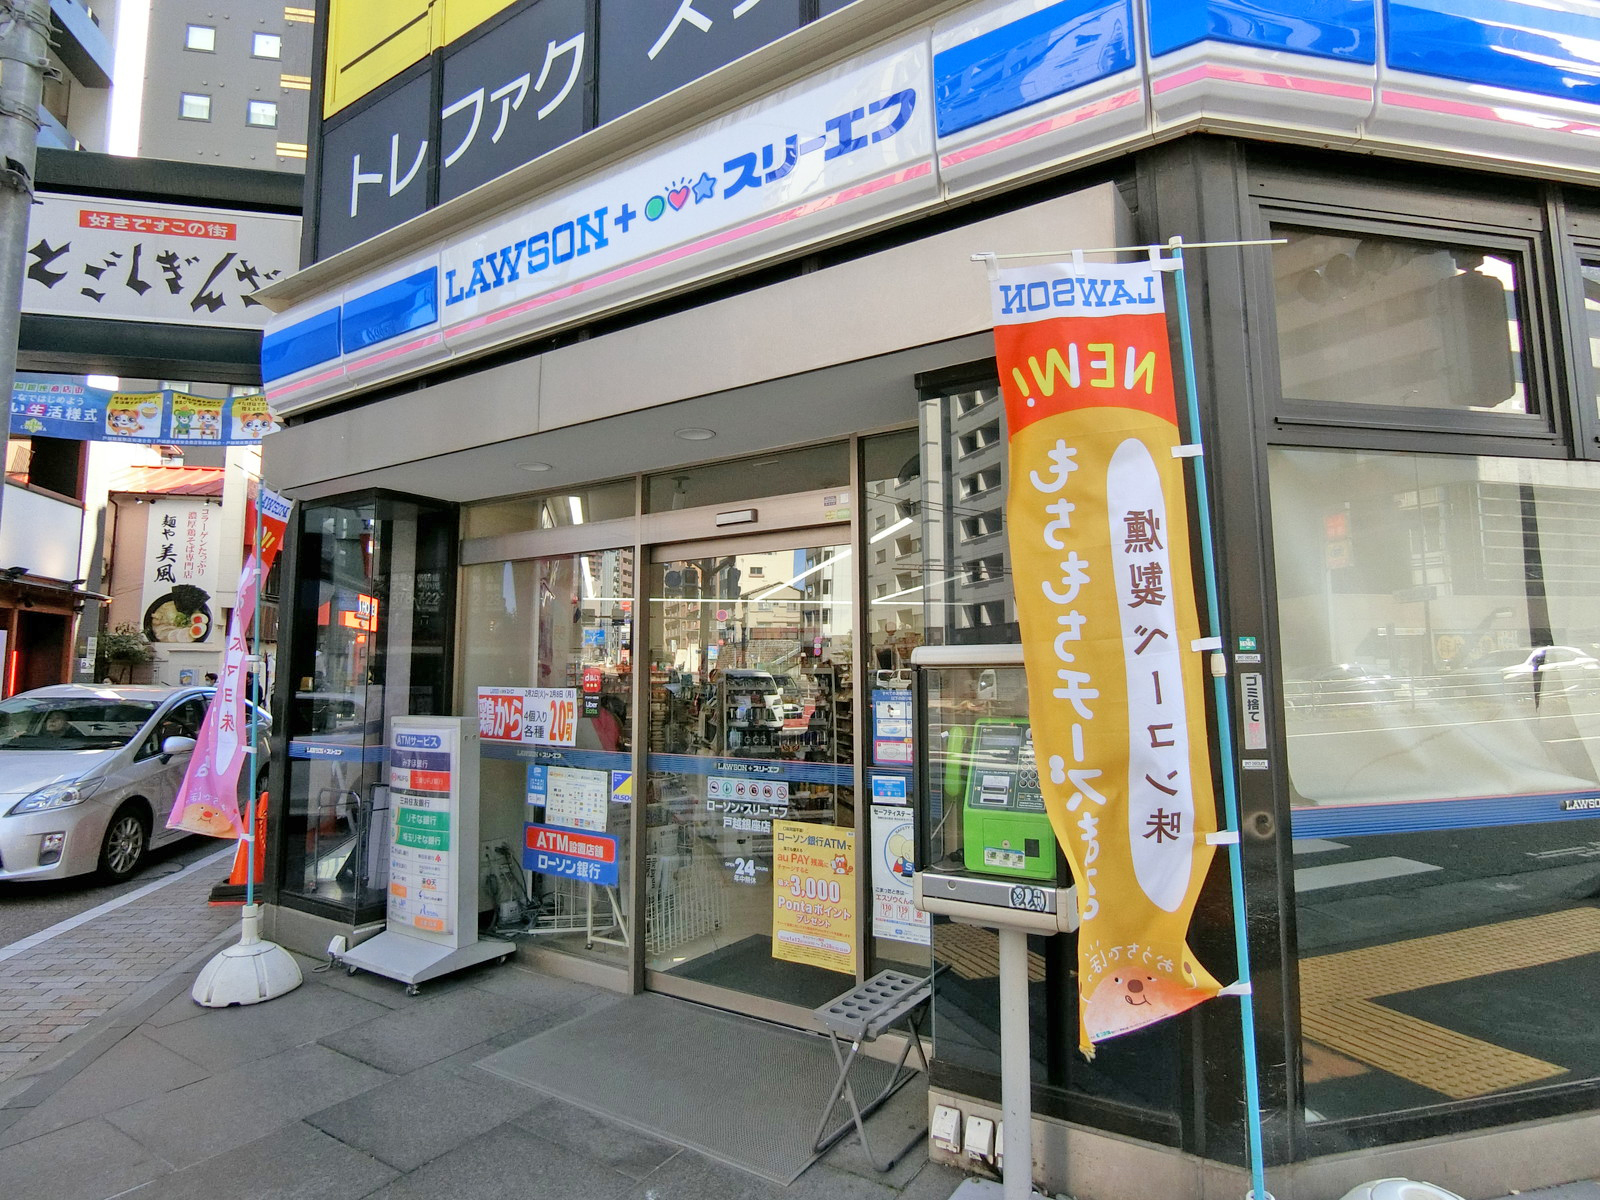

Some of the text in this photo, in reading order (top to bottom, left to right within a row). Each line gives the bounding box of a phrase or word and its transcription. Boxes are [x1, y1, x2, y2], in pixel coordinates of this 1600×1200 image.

[351, 32, 585, 217] トレファク
[446, 206, 608, 306] LAWSON
[723, 88, 916, 199] スリーエフ
[88, 213, 228, 238] 好きですこの街
[11, 402, 98, 421] い生活様式
[154, 514, 178, 583] 麺や美風
[183, 511, 198, 580] 濃厚鶏そば専門店
[198, 508, 210, 576] コラーゲンたっぷり
[478, 697, 523, 738] 鶏から
[524, 710, 547, 723] 4個入り
[549, 699, 566, 742] 20
[565, 701, 574, 742] 円引
[396, 735, 438, 747] ATMサービス
[524, 724, 544, 739] 各種
[406, 813, 437, 826] りそな銀行
[706, 800, 788, 818] ローソン・スリーエフ
[873, 808, 914, 817] セーフティステー
[723, 816, 771, 833] 戸越銀座店
[536, 831, 604, 859] ATM設置店舗
[538, 854, 601, 880] ローソン銀行
[734, 857, 756, 877] 24
[791, 853, 810, 865] PAY
[790, 874, 841, 903] 3,000
[797, 913, 831, 928] プレゼント
